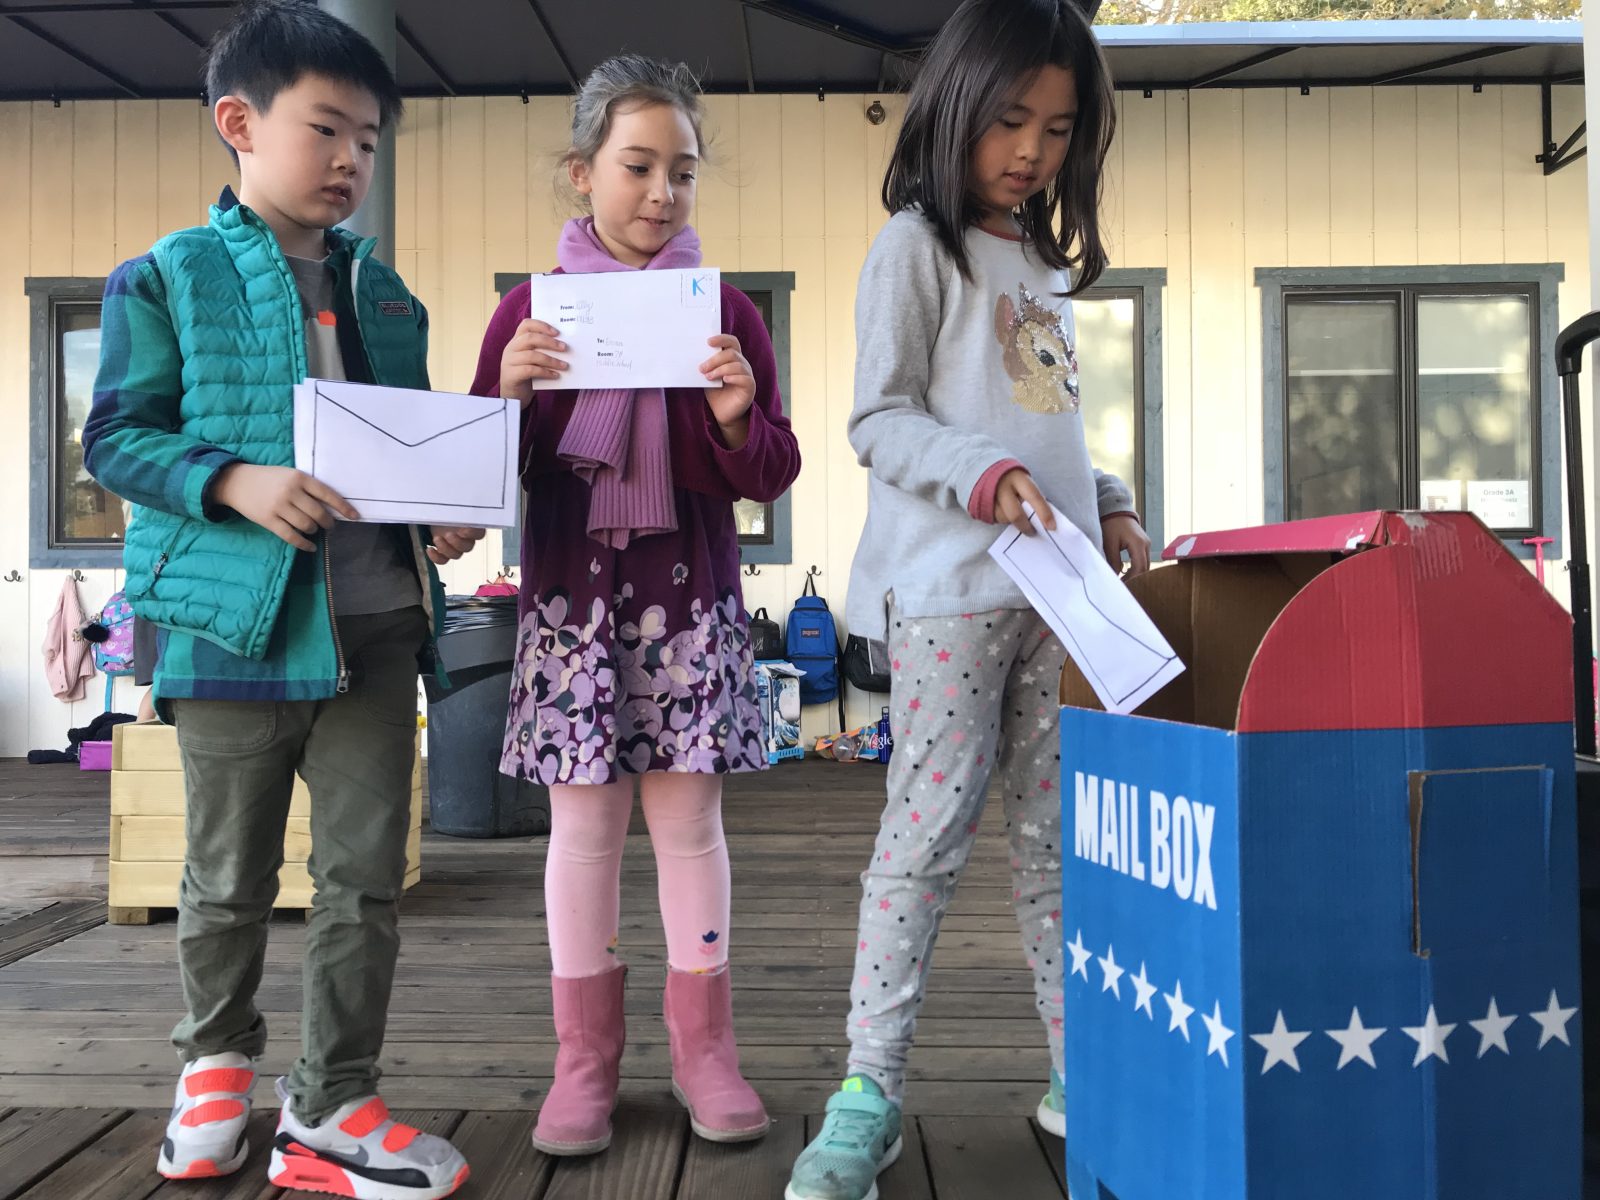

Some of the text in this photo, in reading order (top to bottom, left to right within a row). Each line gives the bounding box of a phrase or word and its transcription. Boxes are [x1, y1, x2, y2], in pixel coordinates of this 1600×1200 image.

[1483, 488, 1515, 496] Grade 3A
[1074, 770, 1218, 911] MAIL BOX
